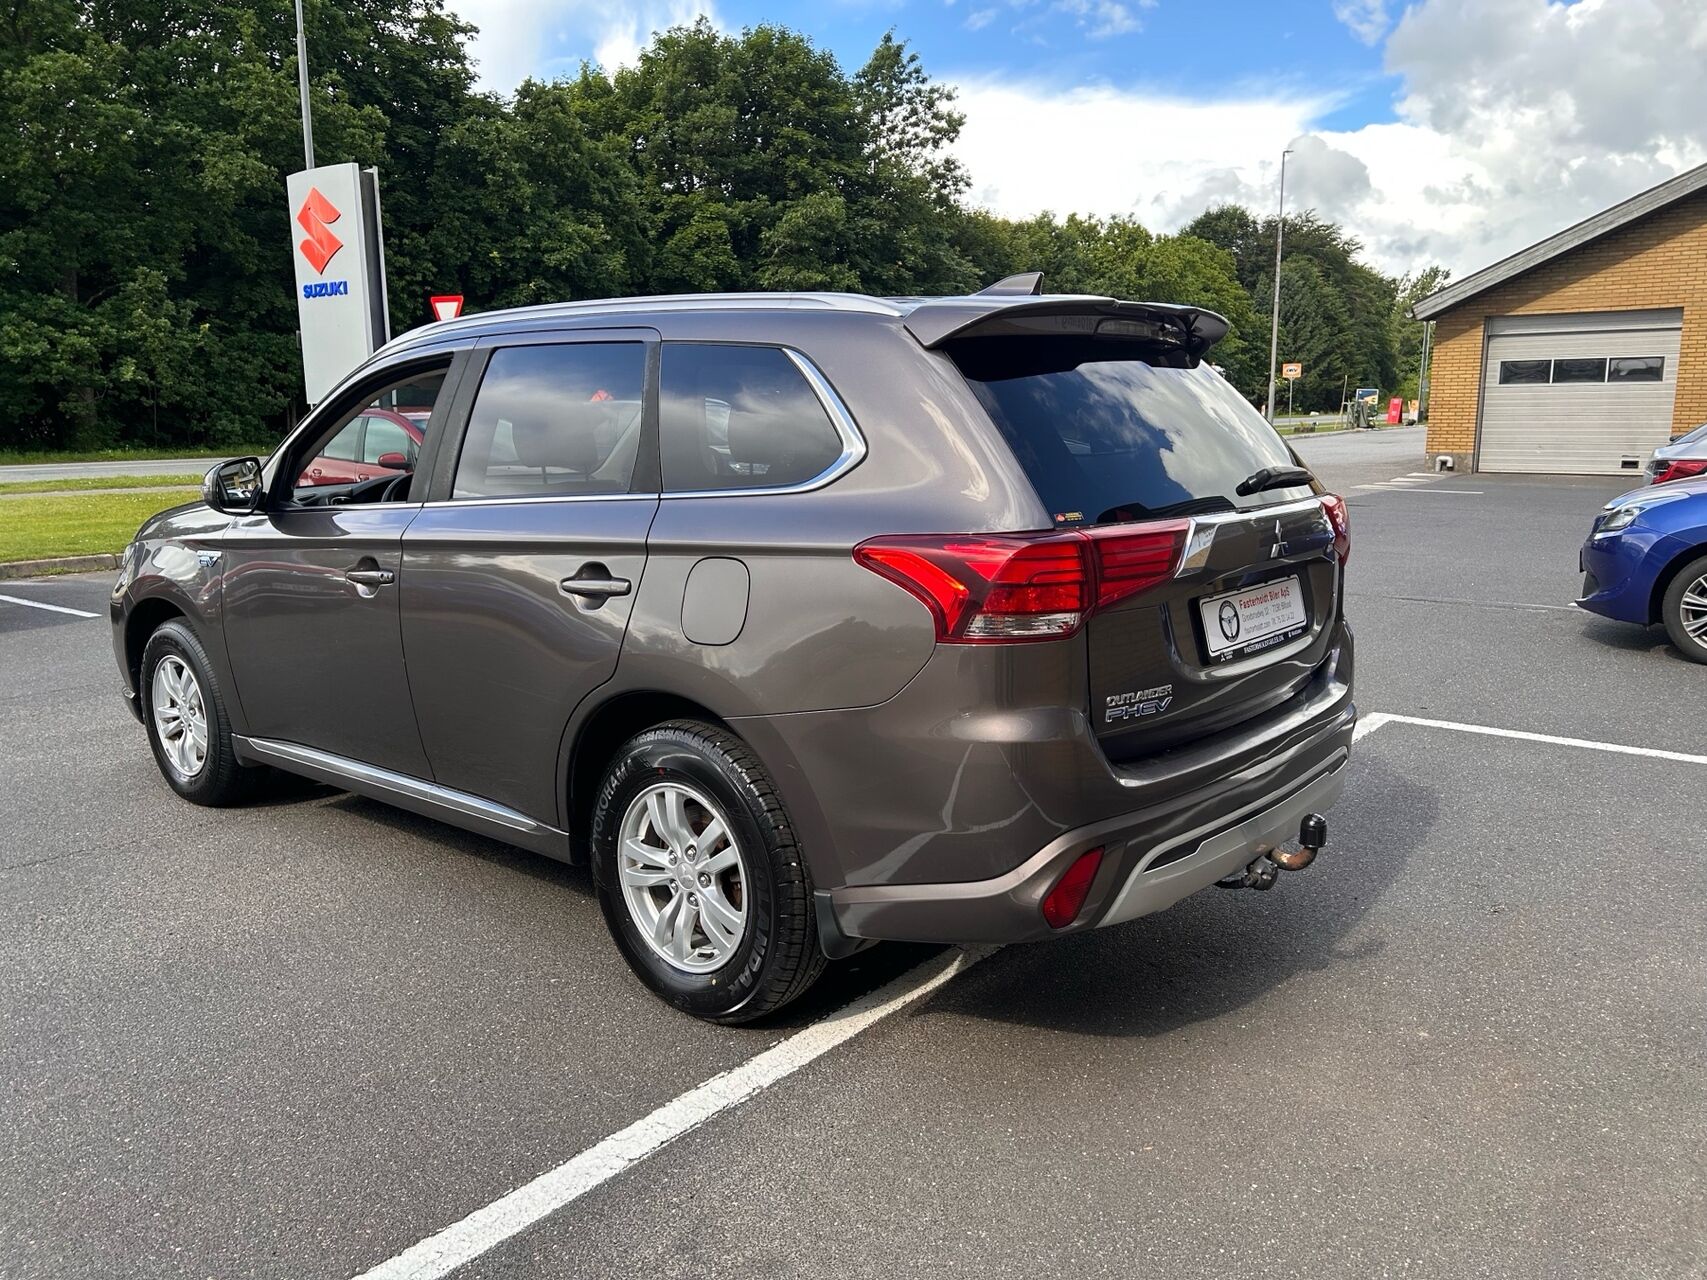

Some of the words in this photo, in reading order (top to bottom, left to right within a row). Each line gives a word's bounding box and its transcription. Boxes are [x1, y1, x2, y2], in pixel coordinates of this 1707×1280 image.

[303, 281, 348, 299] SUZUKI
[1281, 586, 1290, 599] ApS
[1106, 684, 1173, 706] OUTLANDER
[1105, 697, 1173, 722] PHEV
